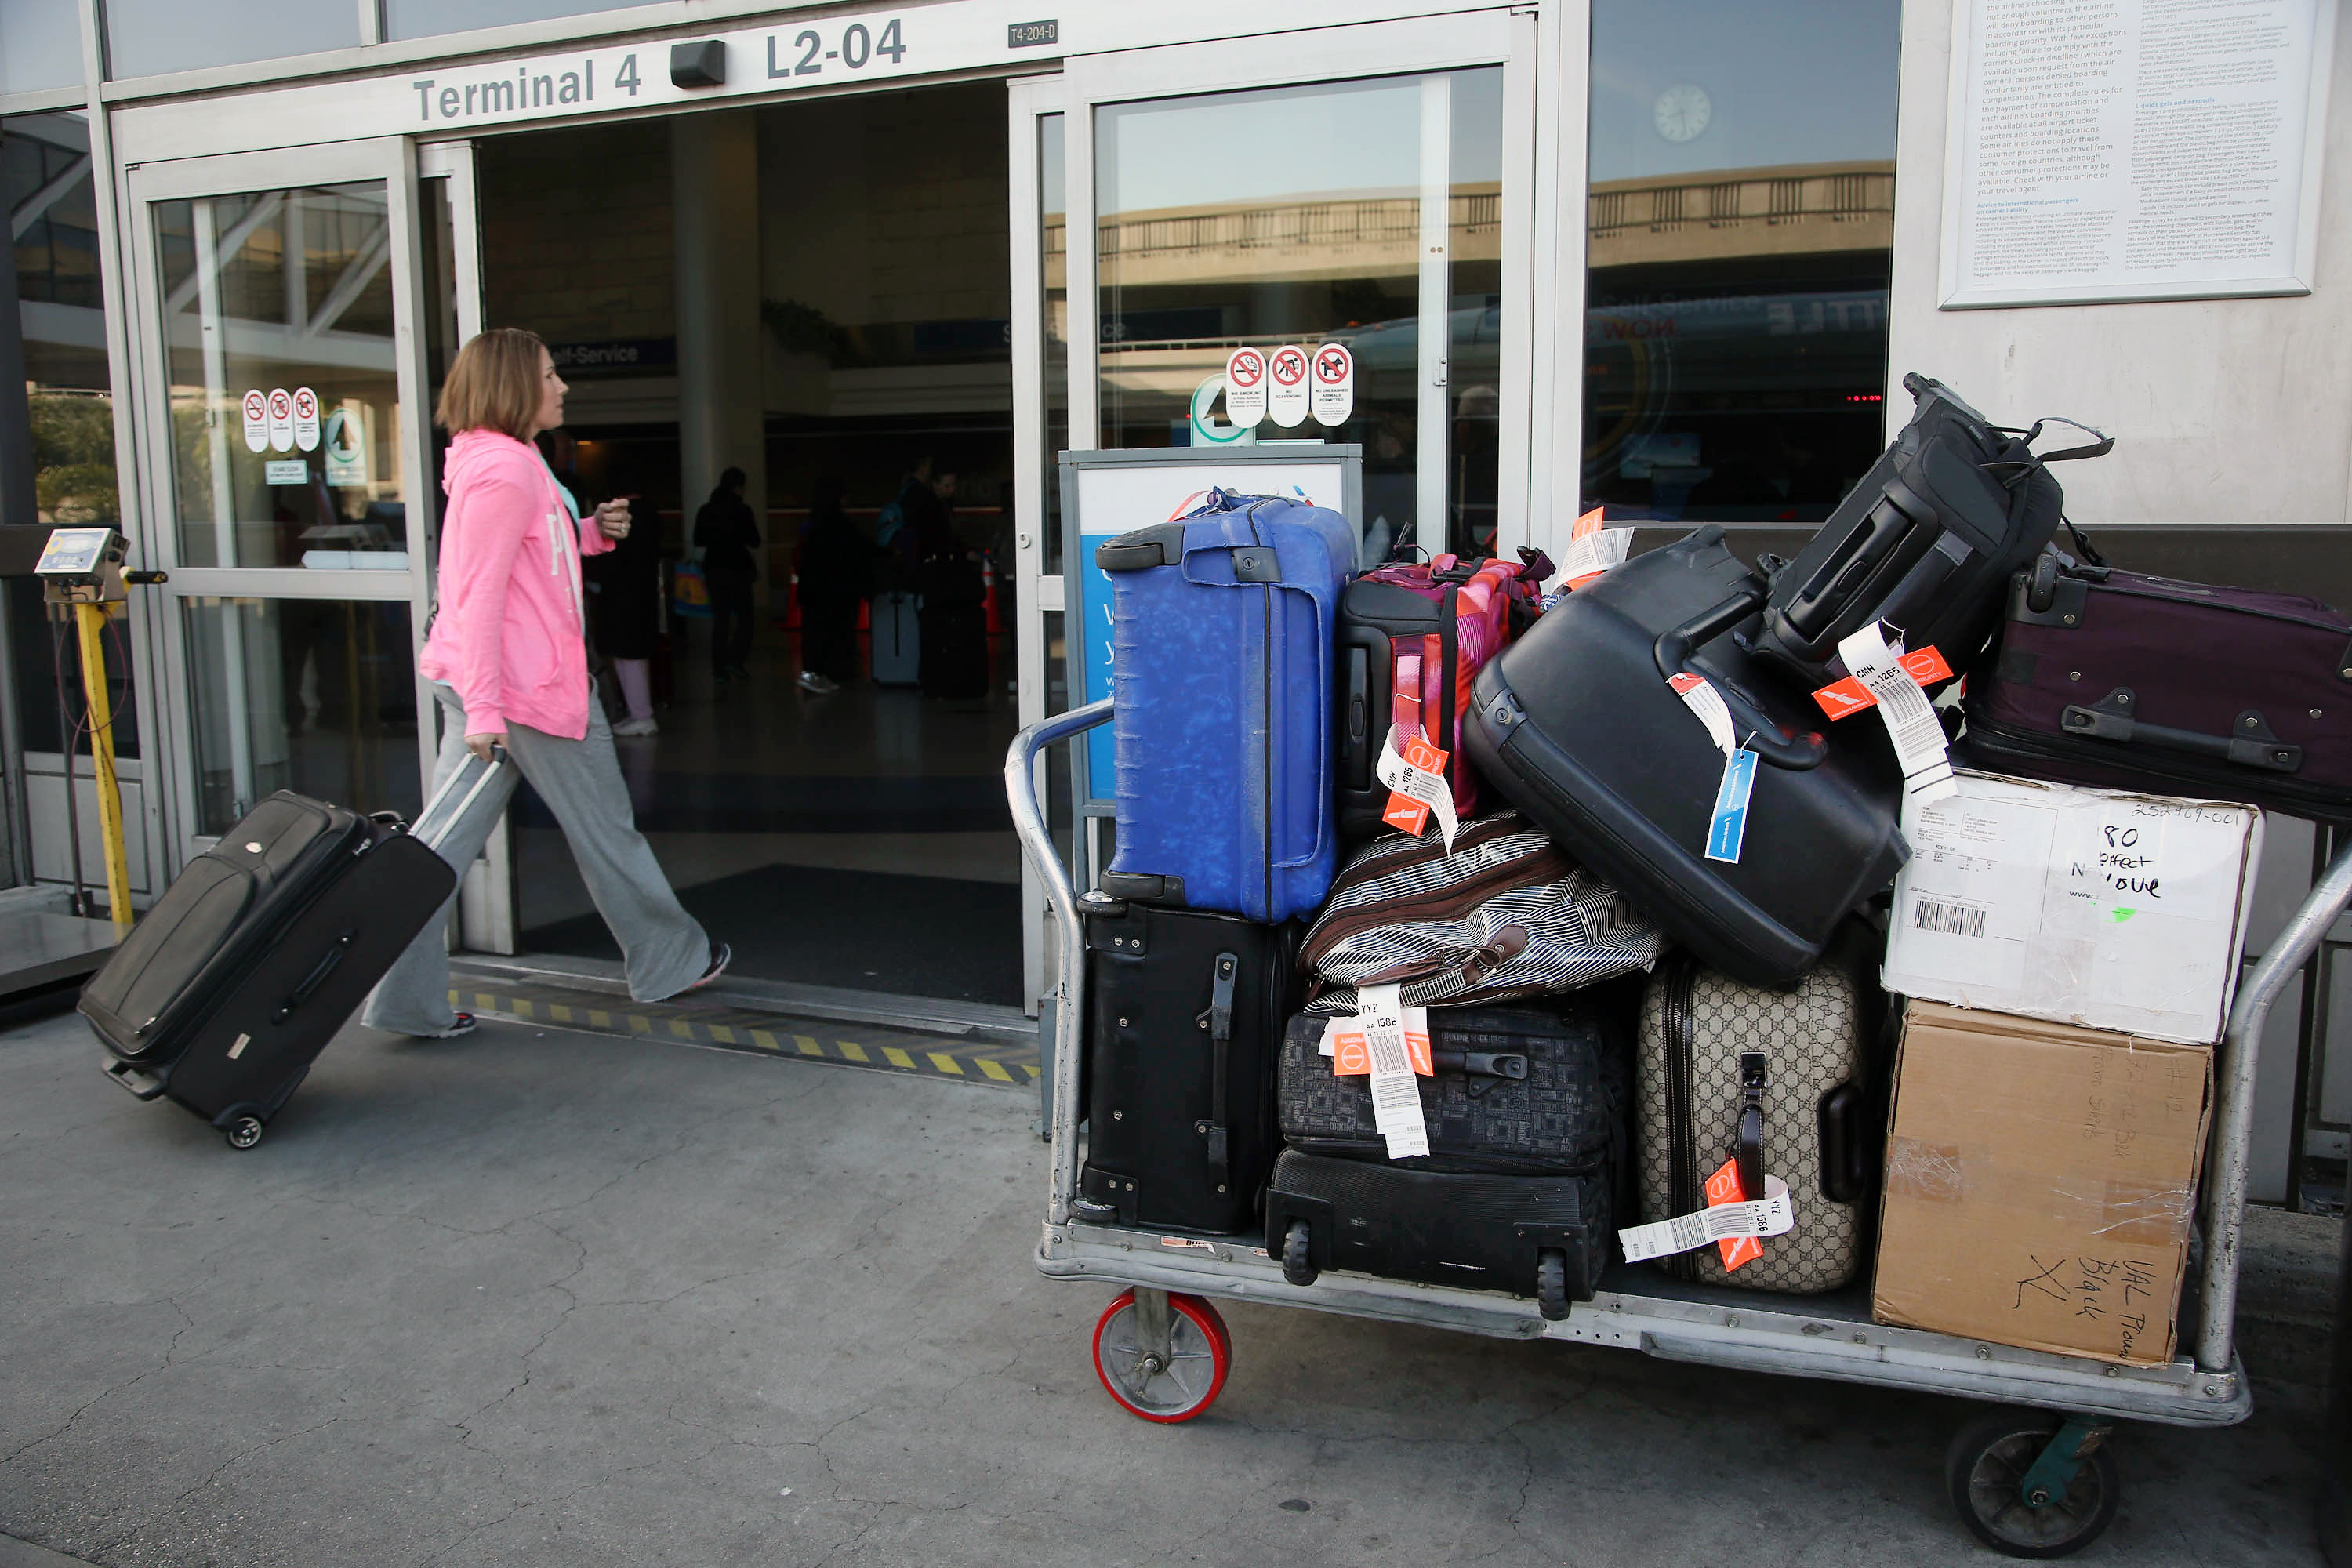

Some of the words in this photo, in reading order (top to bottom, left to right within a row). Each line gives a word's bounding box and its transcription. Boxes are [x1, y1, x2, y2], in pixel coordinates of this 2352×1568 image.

[2001, 10, 2028, 20] enough
[2020, 18, 2053, 27] boarding
[2089, 13, 2118, 23] persons
[1011, 24, 1055, 42] T4-204-D
[1994, 30, 2036, 38] accordance
[2067, 23, 2103, 34] particular
[2085, 31, 2126, 40] exceptions
[767, 18, 906, 79] L2-04
[2053, 43, 2080, 52] comply
[1984, 58, 2013, 67] carrier's
[2014, 56, 2044, 64] check-in
[2046, 53, 2079, 61] deadline
[1984, 67, 2015, 76] available
[2039, 63, 2067, 72] request
[2015, 76, 2044, 85] persons
[414, 60, 594, 121] Terminal
[613, 54, 641, 96] 4
[1983, 85, 2028, 94] involuntarily
[2044, 81, 2073, 89] entitled
[2053, 90, 2089, 99] complete
[1996, 103, 2027, 114] payment
[2039, 100, 2092, 110] compensation
[2000, 112, 2028, 121] airline's
[2065, 108, 2099, 118] priorities
[1994, 122, 2027, 130] available
[2049, 118, 2074, 128] airport
[2056, 137, 2077, 147] apply
[2017, 148, 2059, 158] protections
[2067, 154, 2100, 162] although
[2038, 165, 2080, 175] protections
[553, 345, 638, 365] elf-Service
[1856, 664, 1876, 679] CMH
[1869, 680, 1879, 688] AA
[1878, 666, 1900, 682] 1265
[1387, 771, 1397, 788] CMH
[1403, 765, 1414, 782] 1265
[1403, 782, 1410, 793] AA
[2104, 825, 2139, 848] 80
[1361, 1004, 1379, 1014] YYZ
[1377, 1017, 1397, 1028] 1586
[1754, 1203, 1760, 1213] AA
[1769, 1198, 1782, 1216] YYZ
[1755, 1214, 1769, 1232] 1586
[2012, 1254, 2071, 1310] XL
